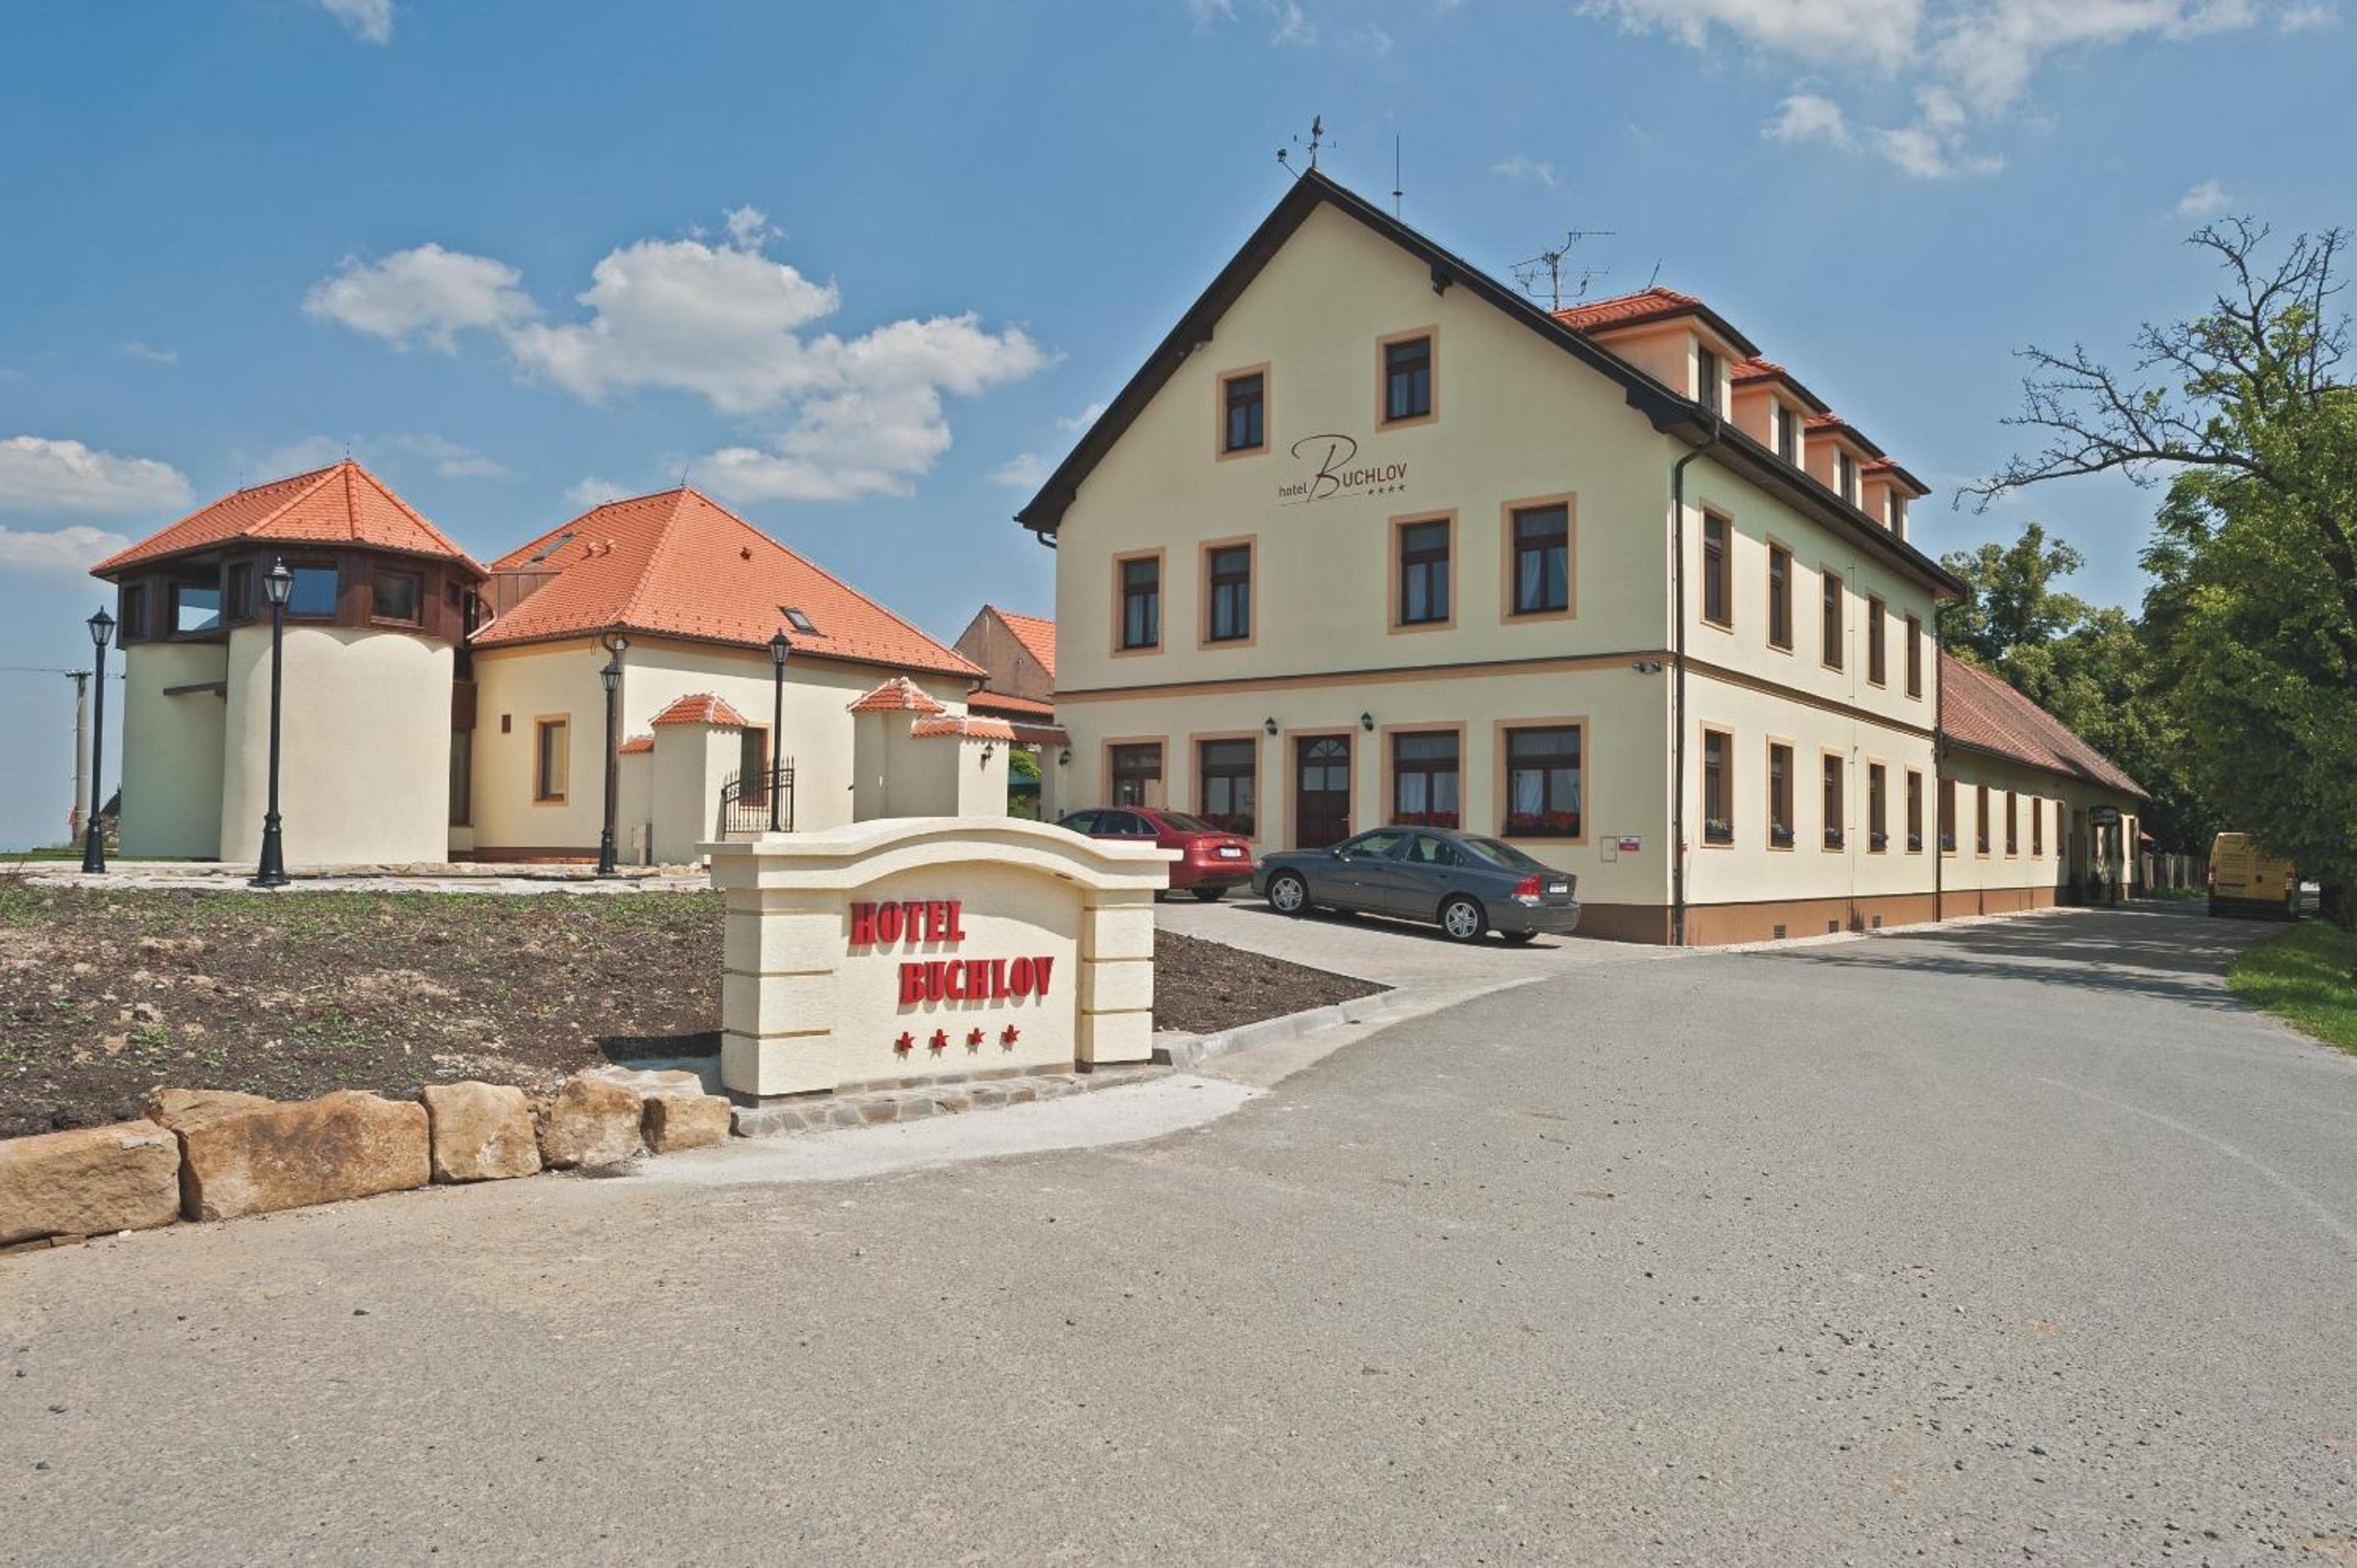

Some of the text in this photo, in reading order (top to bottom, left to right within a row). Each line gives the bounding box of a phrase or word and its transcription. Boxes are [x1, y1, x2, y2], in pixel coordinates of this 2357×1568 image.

[1279, 435, 1407, 502] hotel BUCHLOV
[850, 900, 964, 944] HOTEL
[899, 957, 1054, 1004] BUCHLOV
